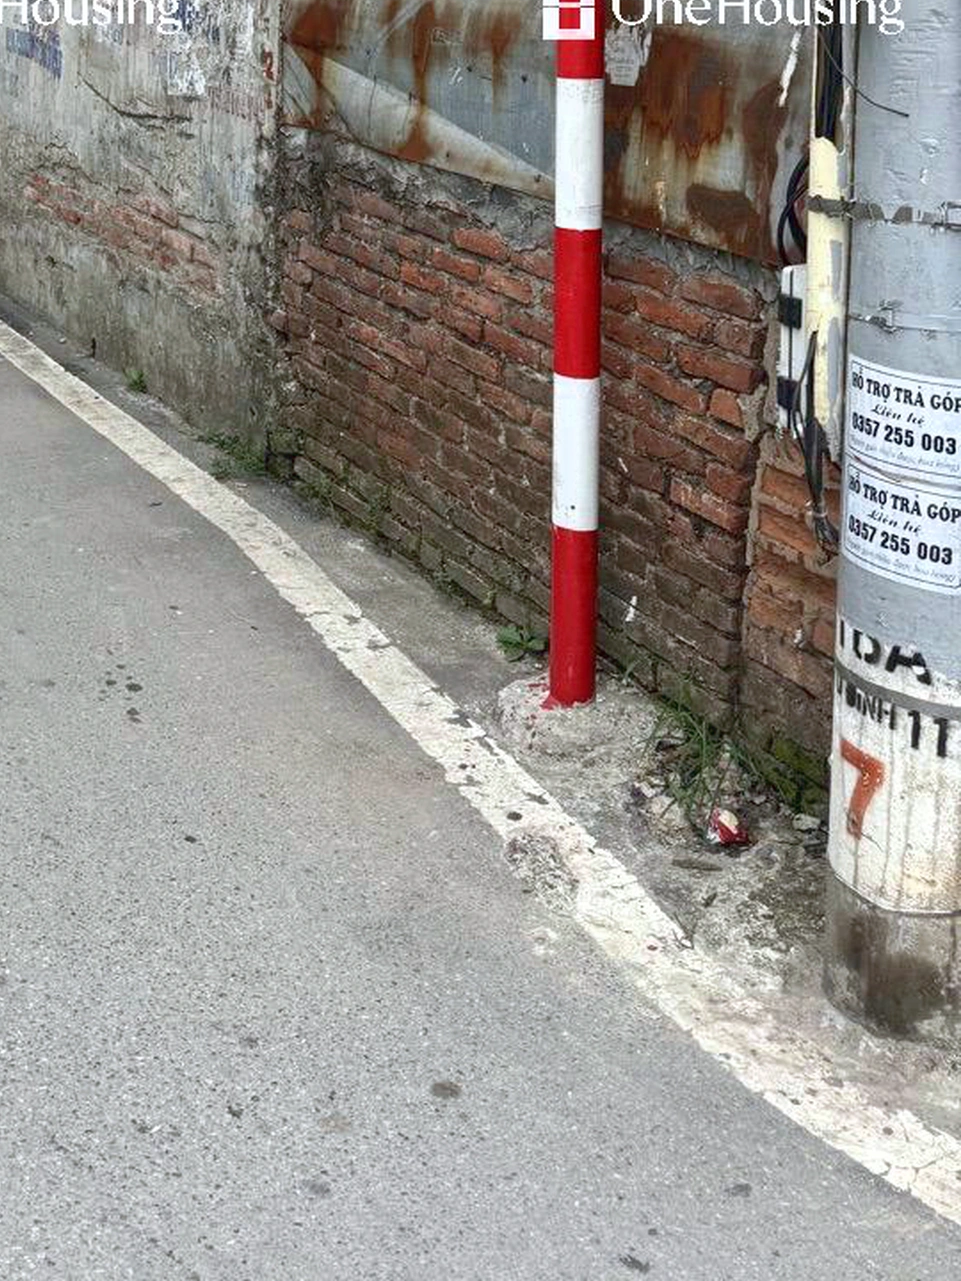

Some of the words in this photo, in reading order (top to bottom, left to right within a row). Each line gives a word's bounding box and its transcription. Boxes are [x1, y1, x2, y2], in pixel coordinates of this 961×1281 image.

[866, 378, 891, 404] TRỢ
[893, 385, 925, 409] TRẢ
[930, 391, 961, 414] GÓP
[852, 411, 880, 438] 0357
[884, 424, 915, 448] 255
[921, 433, 957, 455] 003
[863, 483, 889, 510] TRỢ
[890, 494, 922, 517] TRẢ
[927, 501, 961, 524] GÓP
[849, 514, 877, 543] 0357
[880, 531, 911, 556] 255
[917, 542, 953, 566] 003
